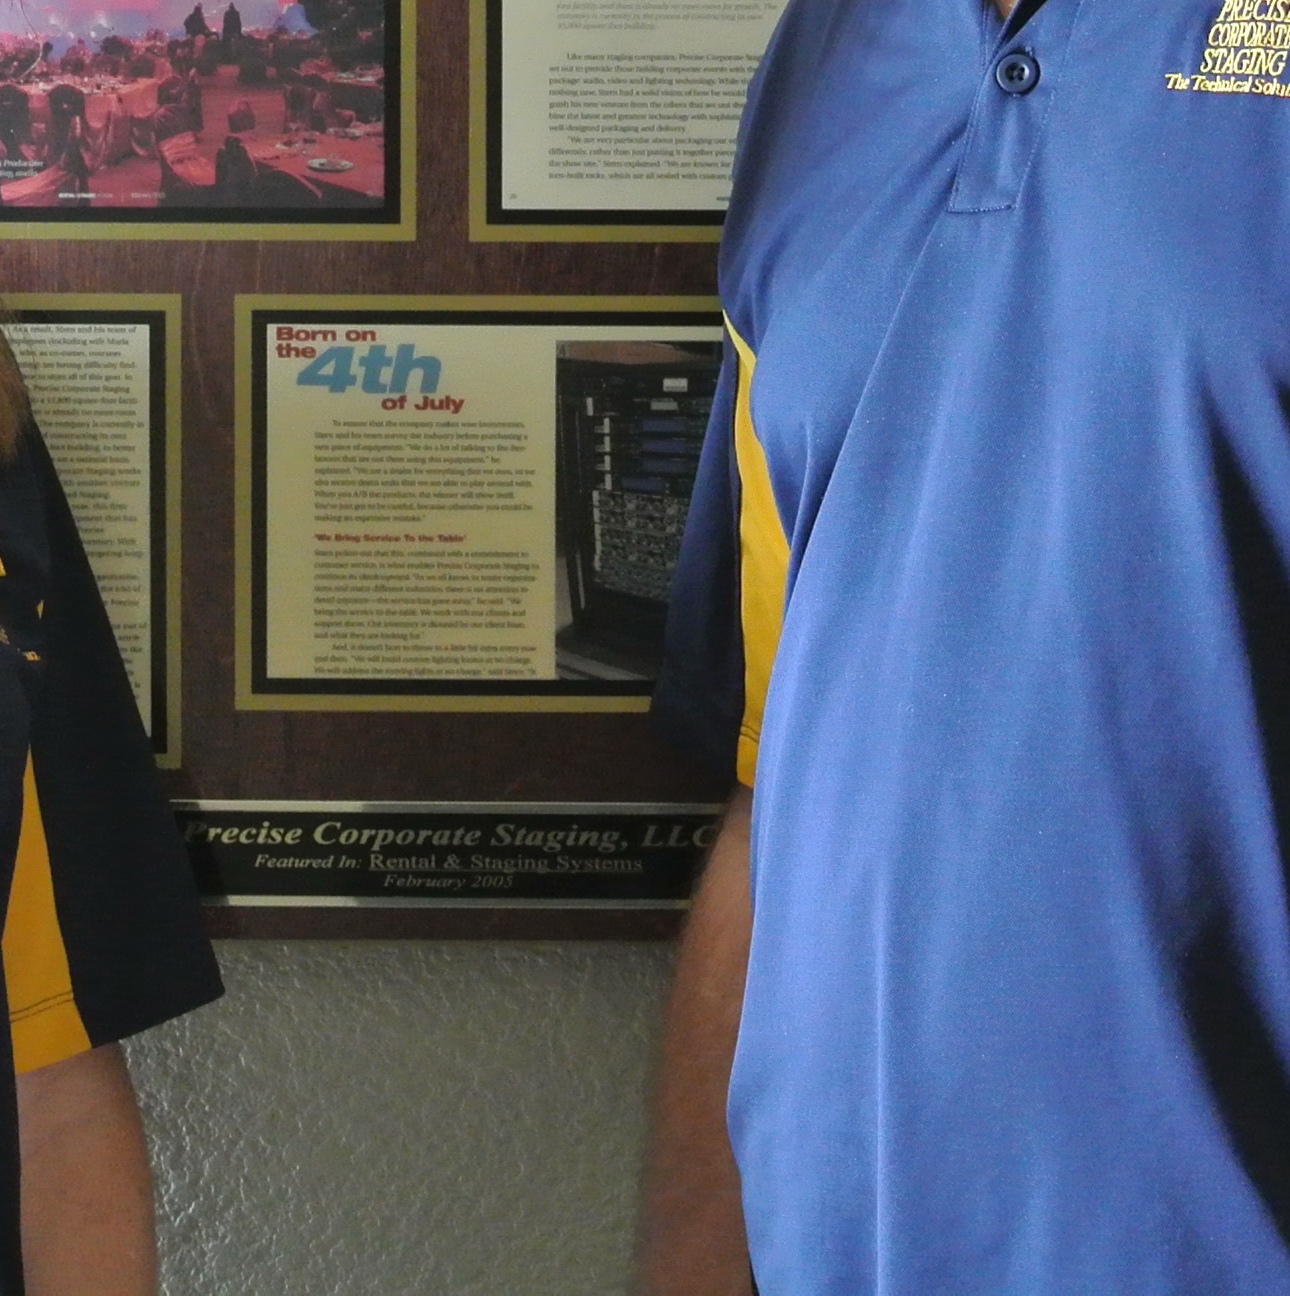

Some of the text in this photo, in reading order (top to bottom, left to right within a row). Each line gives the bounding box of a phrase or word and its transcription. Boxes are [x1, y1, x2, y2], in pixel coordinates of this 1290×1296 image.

[1200, 48, 1288, 76] STAGING
[1165, 73, 1191, 90] The
[276, 327, 376, 342] Born on
[276, 344, 442, 394] the 4th
[381, 396, 465, 414] of July
[403, 533, 415, 543] To
[417, 533, 433, 543] the
[184, 822, 301, 845] Precise
[313, 822, 482, 851] Corporate
[491, 823, 628, 852] Staging,
[254, 854, 643, 873] Featured In: Rental & Staging Systems
[384, 875, 514, 891] February 2005
